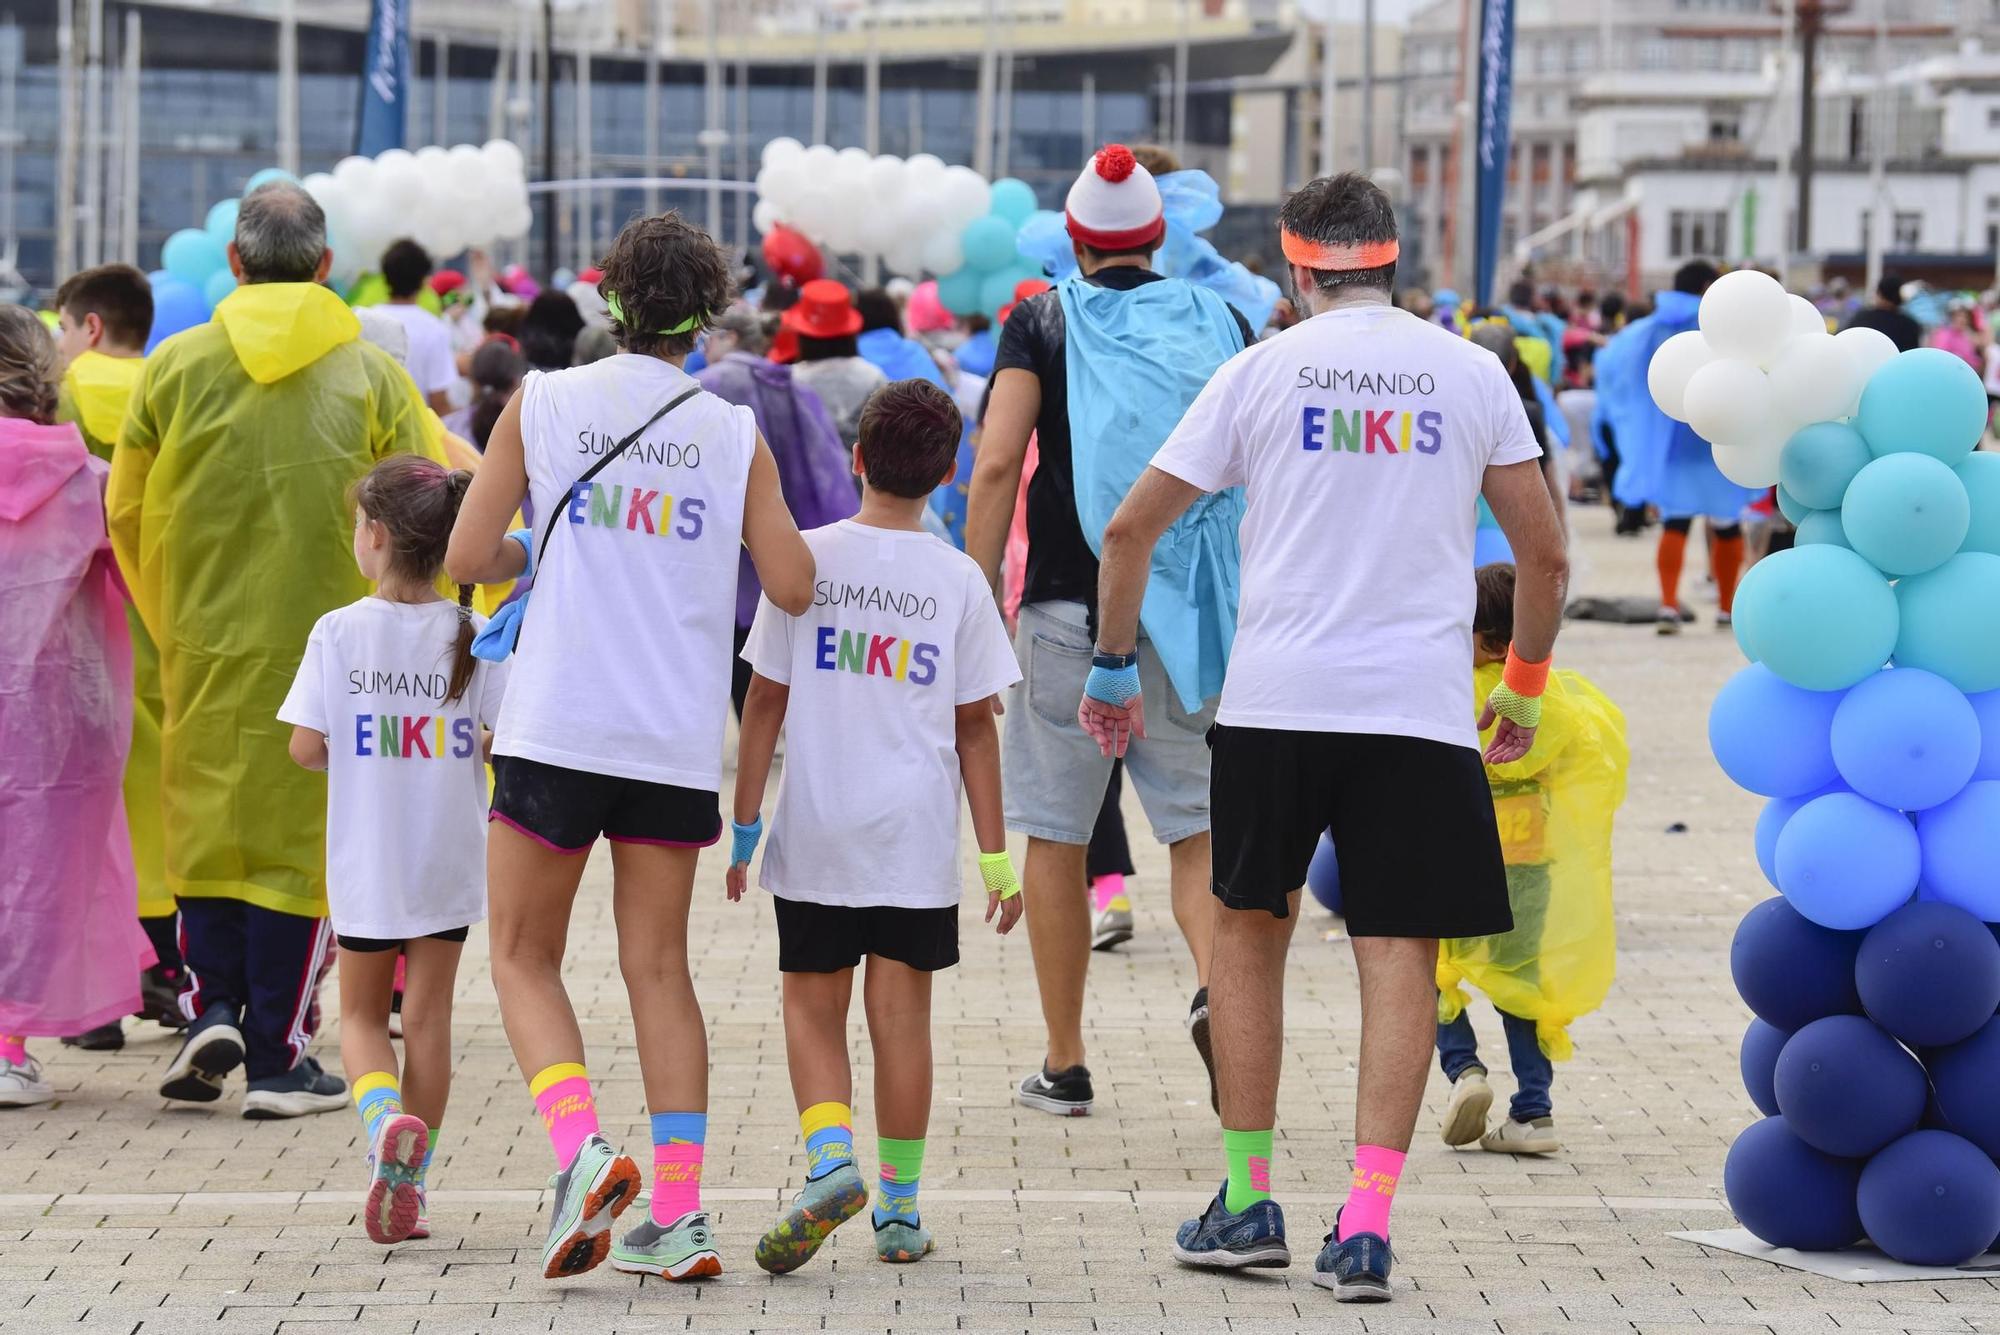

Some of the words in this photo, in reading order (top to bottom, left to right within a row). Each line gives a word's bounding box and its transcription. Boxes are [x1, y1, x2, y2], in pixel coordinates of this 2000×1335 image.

[1297, 366, 1436, 396] SUMANDO
[1302, 406, 1443, 455] ENKIS
[568, 481, 707, 541] ENKIS
[814, 580, 937, 620] SUMANDO
[815, 626, 941, 686] ENKIS
[349, 669, 460, 700] SUMAND
[355, 714, 475, 759] ENKIS
